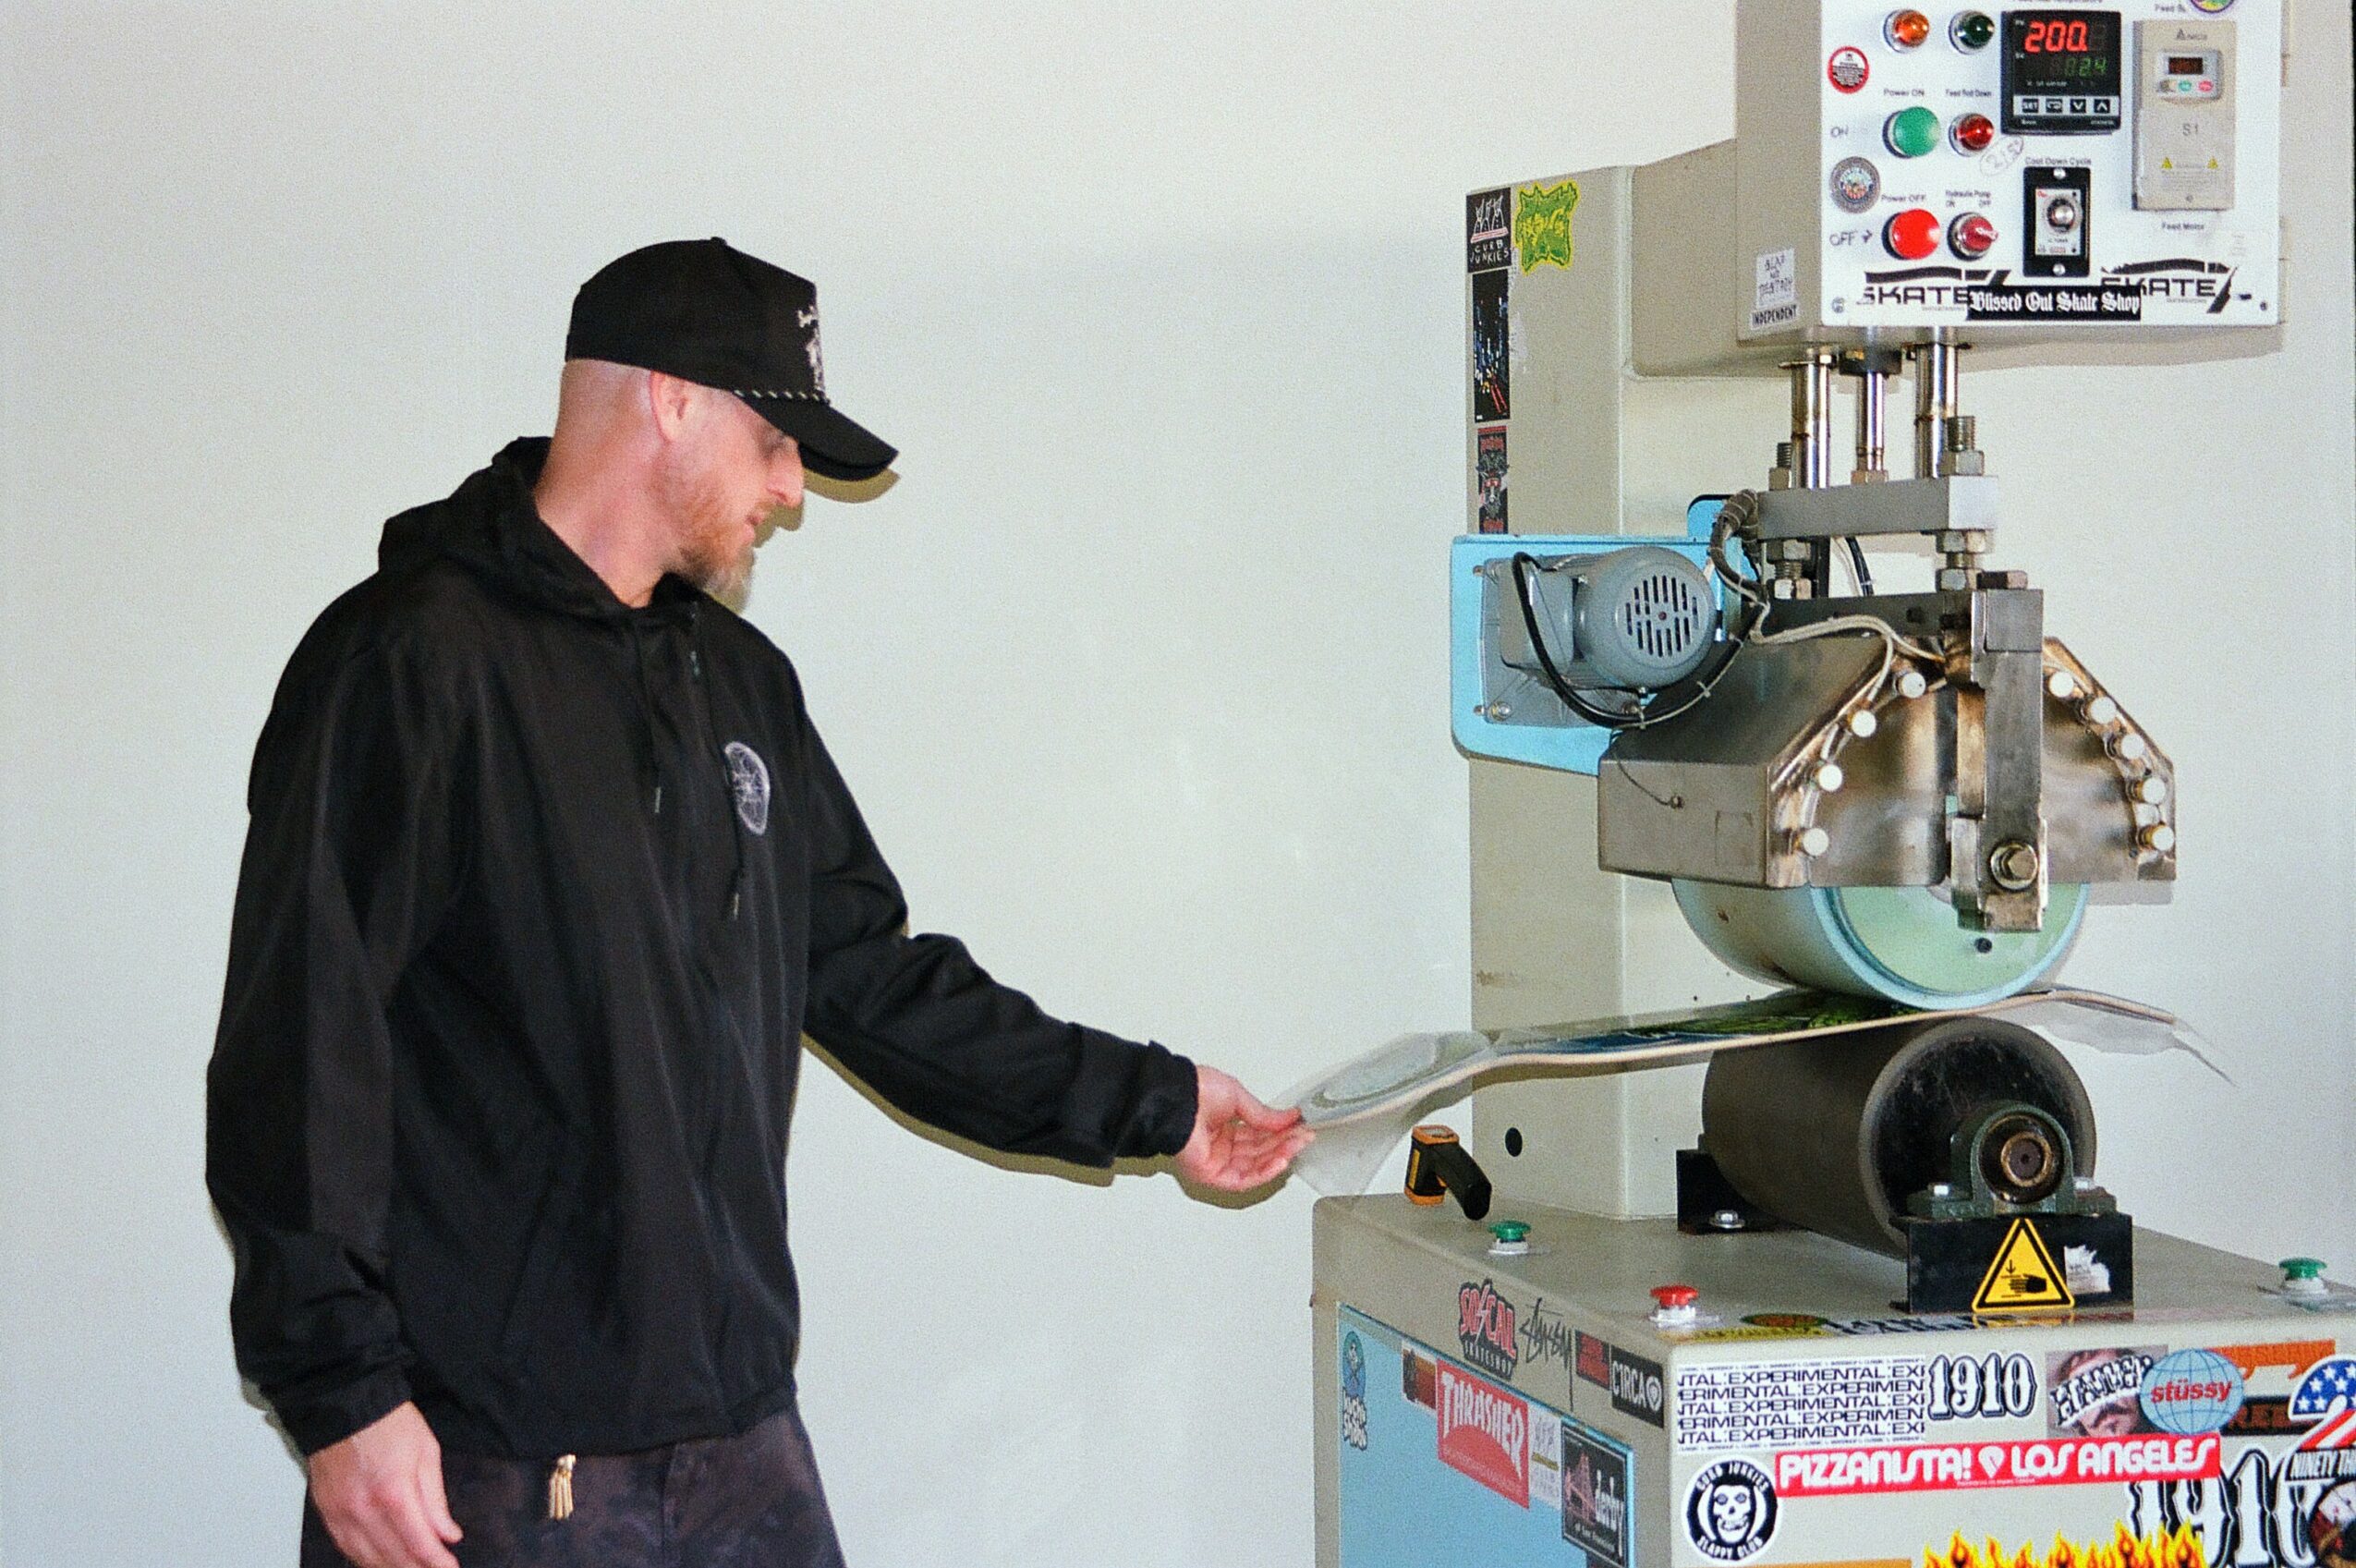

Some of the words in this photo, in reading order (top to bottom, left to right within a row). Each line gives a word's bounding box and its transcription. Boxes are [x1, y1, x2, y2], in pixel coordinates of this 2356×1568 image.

[1830, 127, 1847, 138] ON
[1881, 194, 1906, 202] Power
[1909, 194, 1926, 202] OFF
[1475, 239, 1504, 254] CURB
[1829, 231, 1856, 246] OFF
[1470, 248, 1509, 265] JUNKIES
[1970, 291, 2022, 312] Blissed
[2025, 291, 2053, 312] Out
[2056, 291, 2098, 312] Skate
[2101, 291, 2140, 315] Shop
[1928, 1353, 2037, 1420] 1910
[2151, 1378, 2232, 1403] stüssy
[1441, 1371, 1524, 1480] THRASHER
[1779, 1447, 1972, 1489] PIZZANISTA!
[2010, 1443, 2075, 1477] LOS
[2078, 1438, 2216, 1477] ANGELES
[1696, 1464, 1723, 1490] CURB
[1729, 1462, 1769, 1492] JUNKIES
[1596, 1469, 1624, 1558] derby
[1697, 1535, 1732, 1560] SLAPPY
[1737, 1536, 1763, 1559] CLUB
